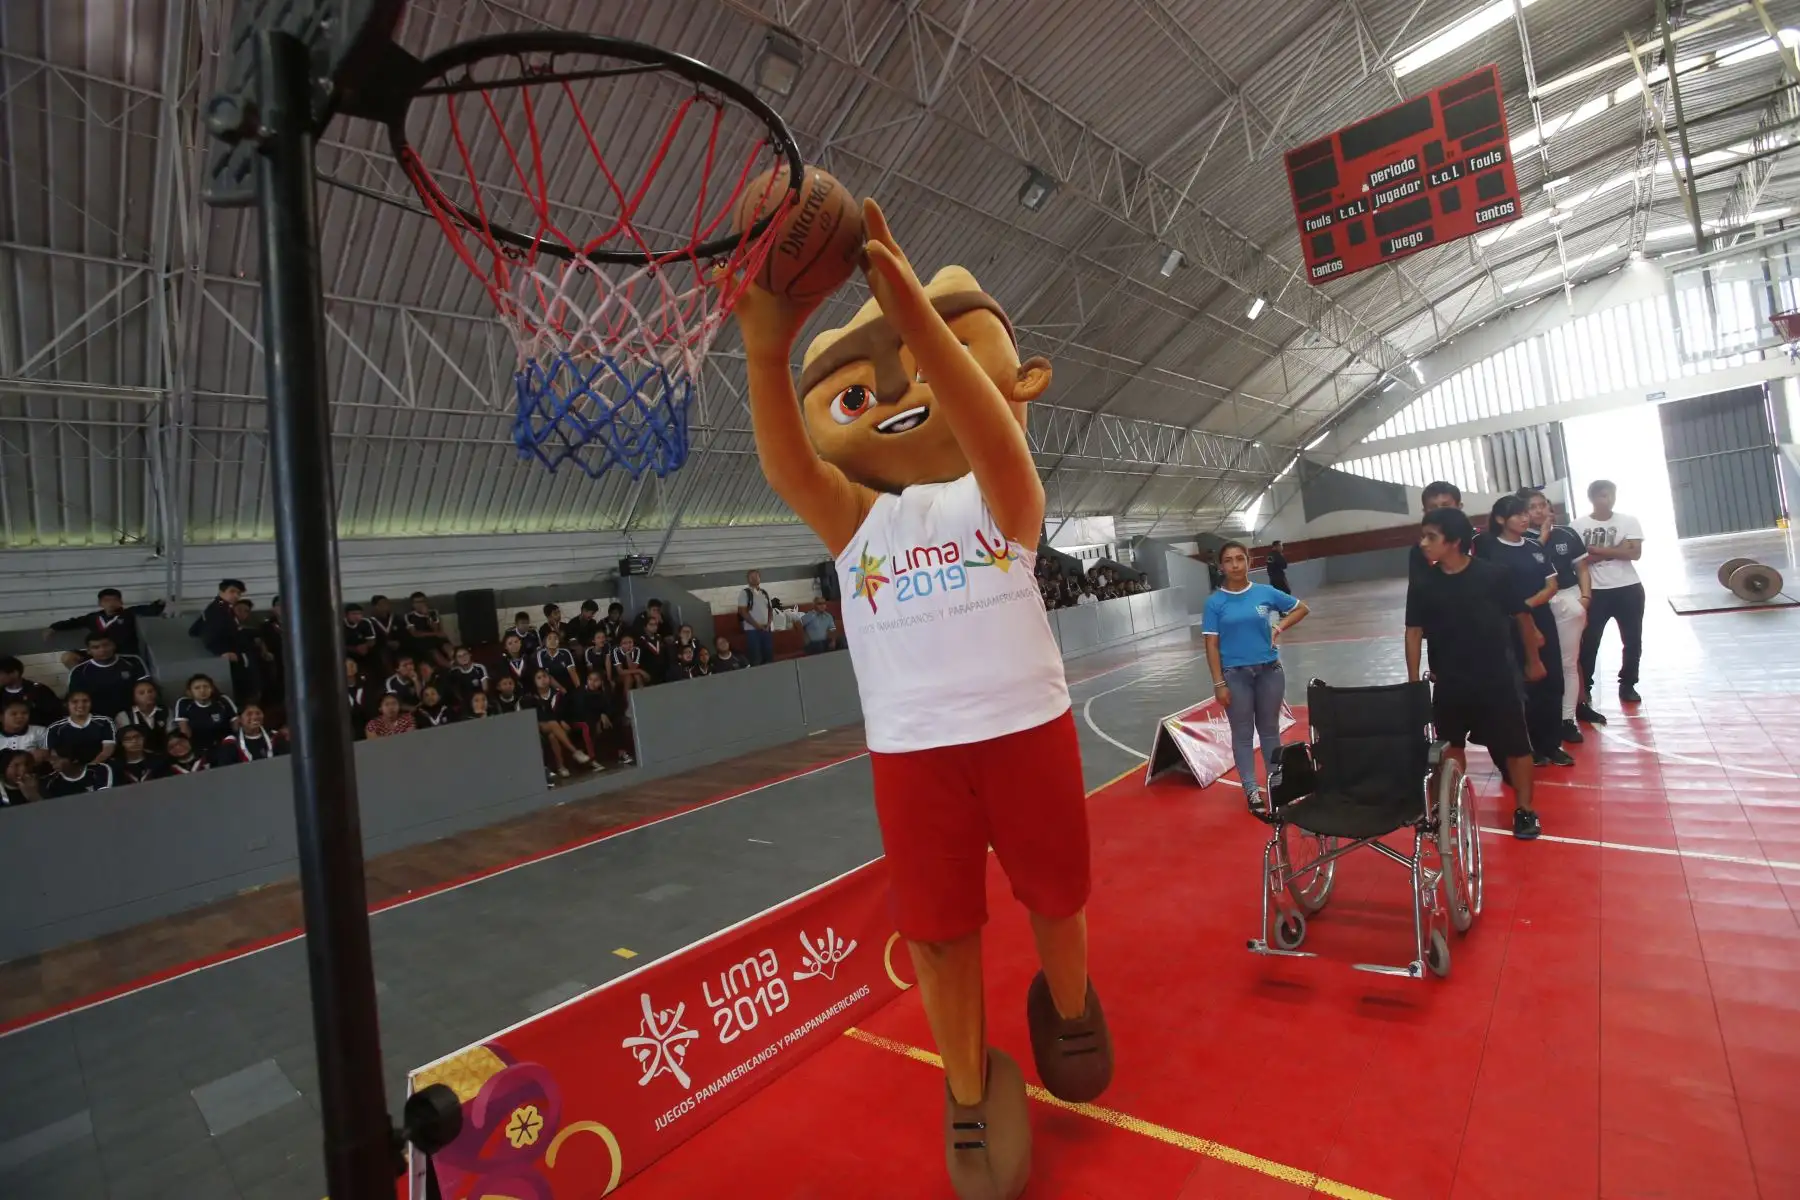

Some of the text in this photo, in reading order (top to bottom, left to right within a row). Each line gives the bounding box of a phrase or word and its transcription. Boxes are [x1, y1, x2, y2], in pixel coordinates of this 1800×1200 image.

[1370, 158, 1416, 187] periodo
[1470, 151, 1502, 171] fouls
[1375, 180, 1421, 208] jugador
[1306, 215, 1332, 232] fouls
[1475, 202, 1515, 224] tantos
[1390, 231, 1424, 253] juego
[1312, 259, 1344, 279] tantos
[896, 564, 967, 602] 2019
[713, 978, 790, 1044] 2019
[654, 984, 870, 1132] JUEGOS PANAMERICANOS Y PARAPANAMERICANOS
